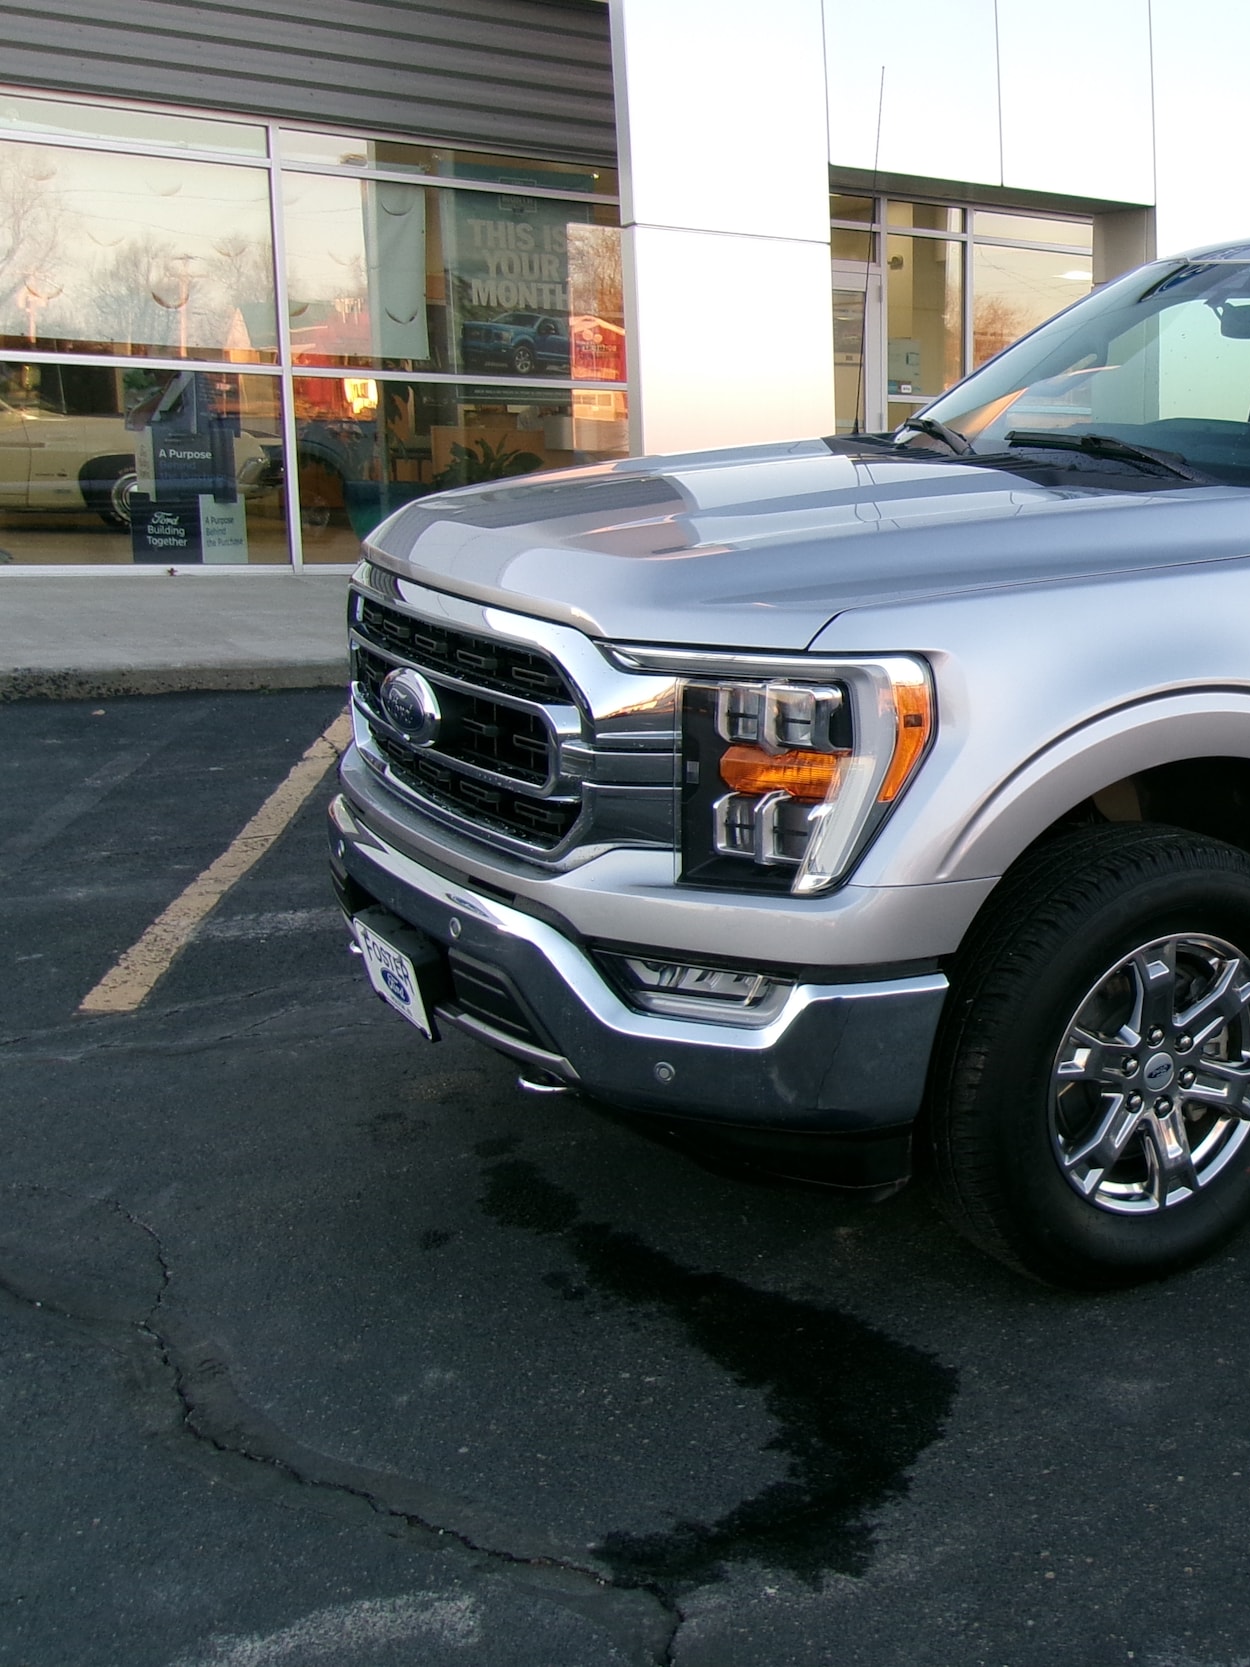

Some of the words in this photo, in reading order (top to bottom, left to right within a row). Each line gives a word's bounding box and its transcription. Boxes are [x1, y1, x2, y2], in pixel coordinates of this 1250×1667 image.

[467, 219, 536, 251] THIS
[483, 249, 560, 281] YOUR
[472, 279, 569, 312] MONTH
[159, 449, 167, 458] A
[169, 449, 213, 460] Purpose
[147, 525, 185, 537] Building
[151, 512, 180, 525] Ford
[146, 536, 188, 547] Together
[364, 931, 415, 995] FOSTER
[386, 972, 406, 1000] Ford
